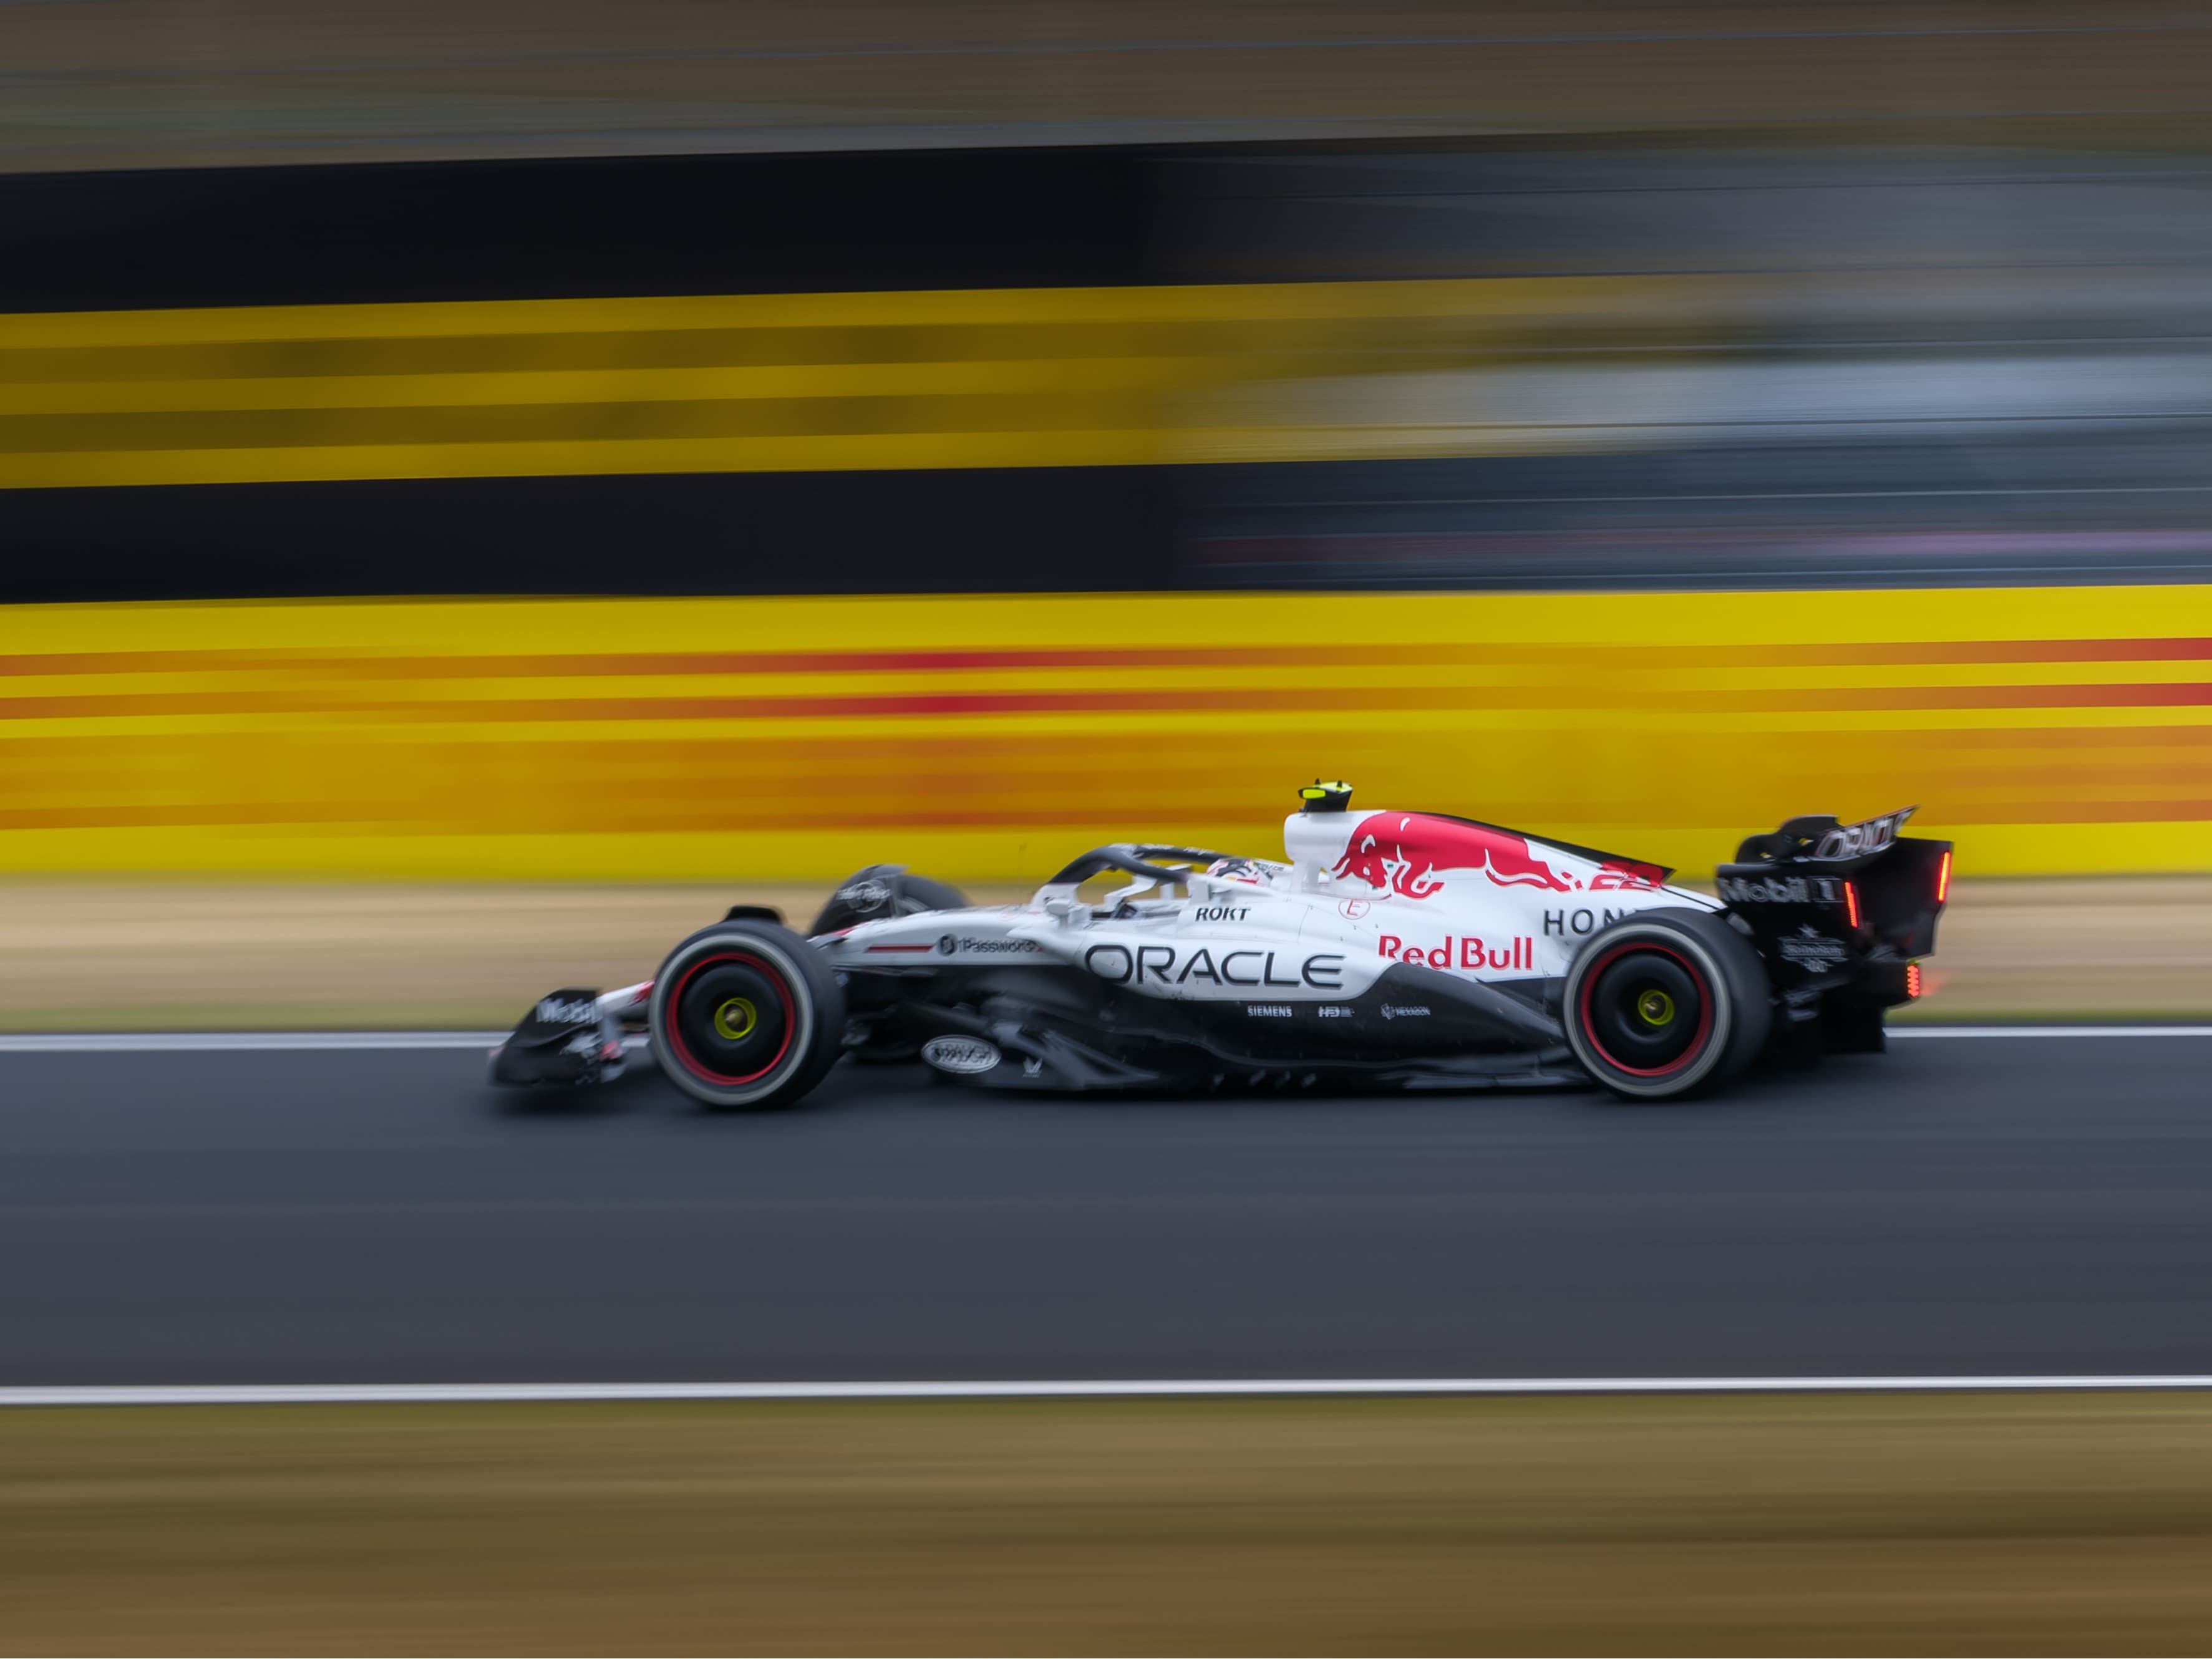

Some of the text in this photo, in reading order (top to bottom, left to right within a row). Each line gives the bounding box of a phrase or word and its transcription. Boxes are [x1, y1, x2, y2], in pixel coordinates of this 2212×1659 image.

[1717, 877, 1810, 902] Mobil
[1195, 907, 1251, 921] ROKT
[1544, 907, 1626, 936] HON
[1378, 934, 1533, 971] Red Bull
[1085, 944, 1347, 990] ORACLE
[1247, 1005, 1293, 1017] SIEMENS
